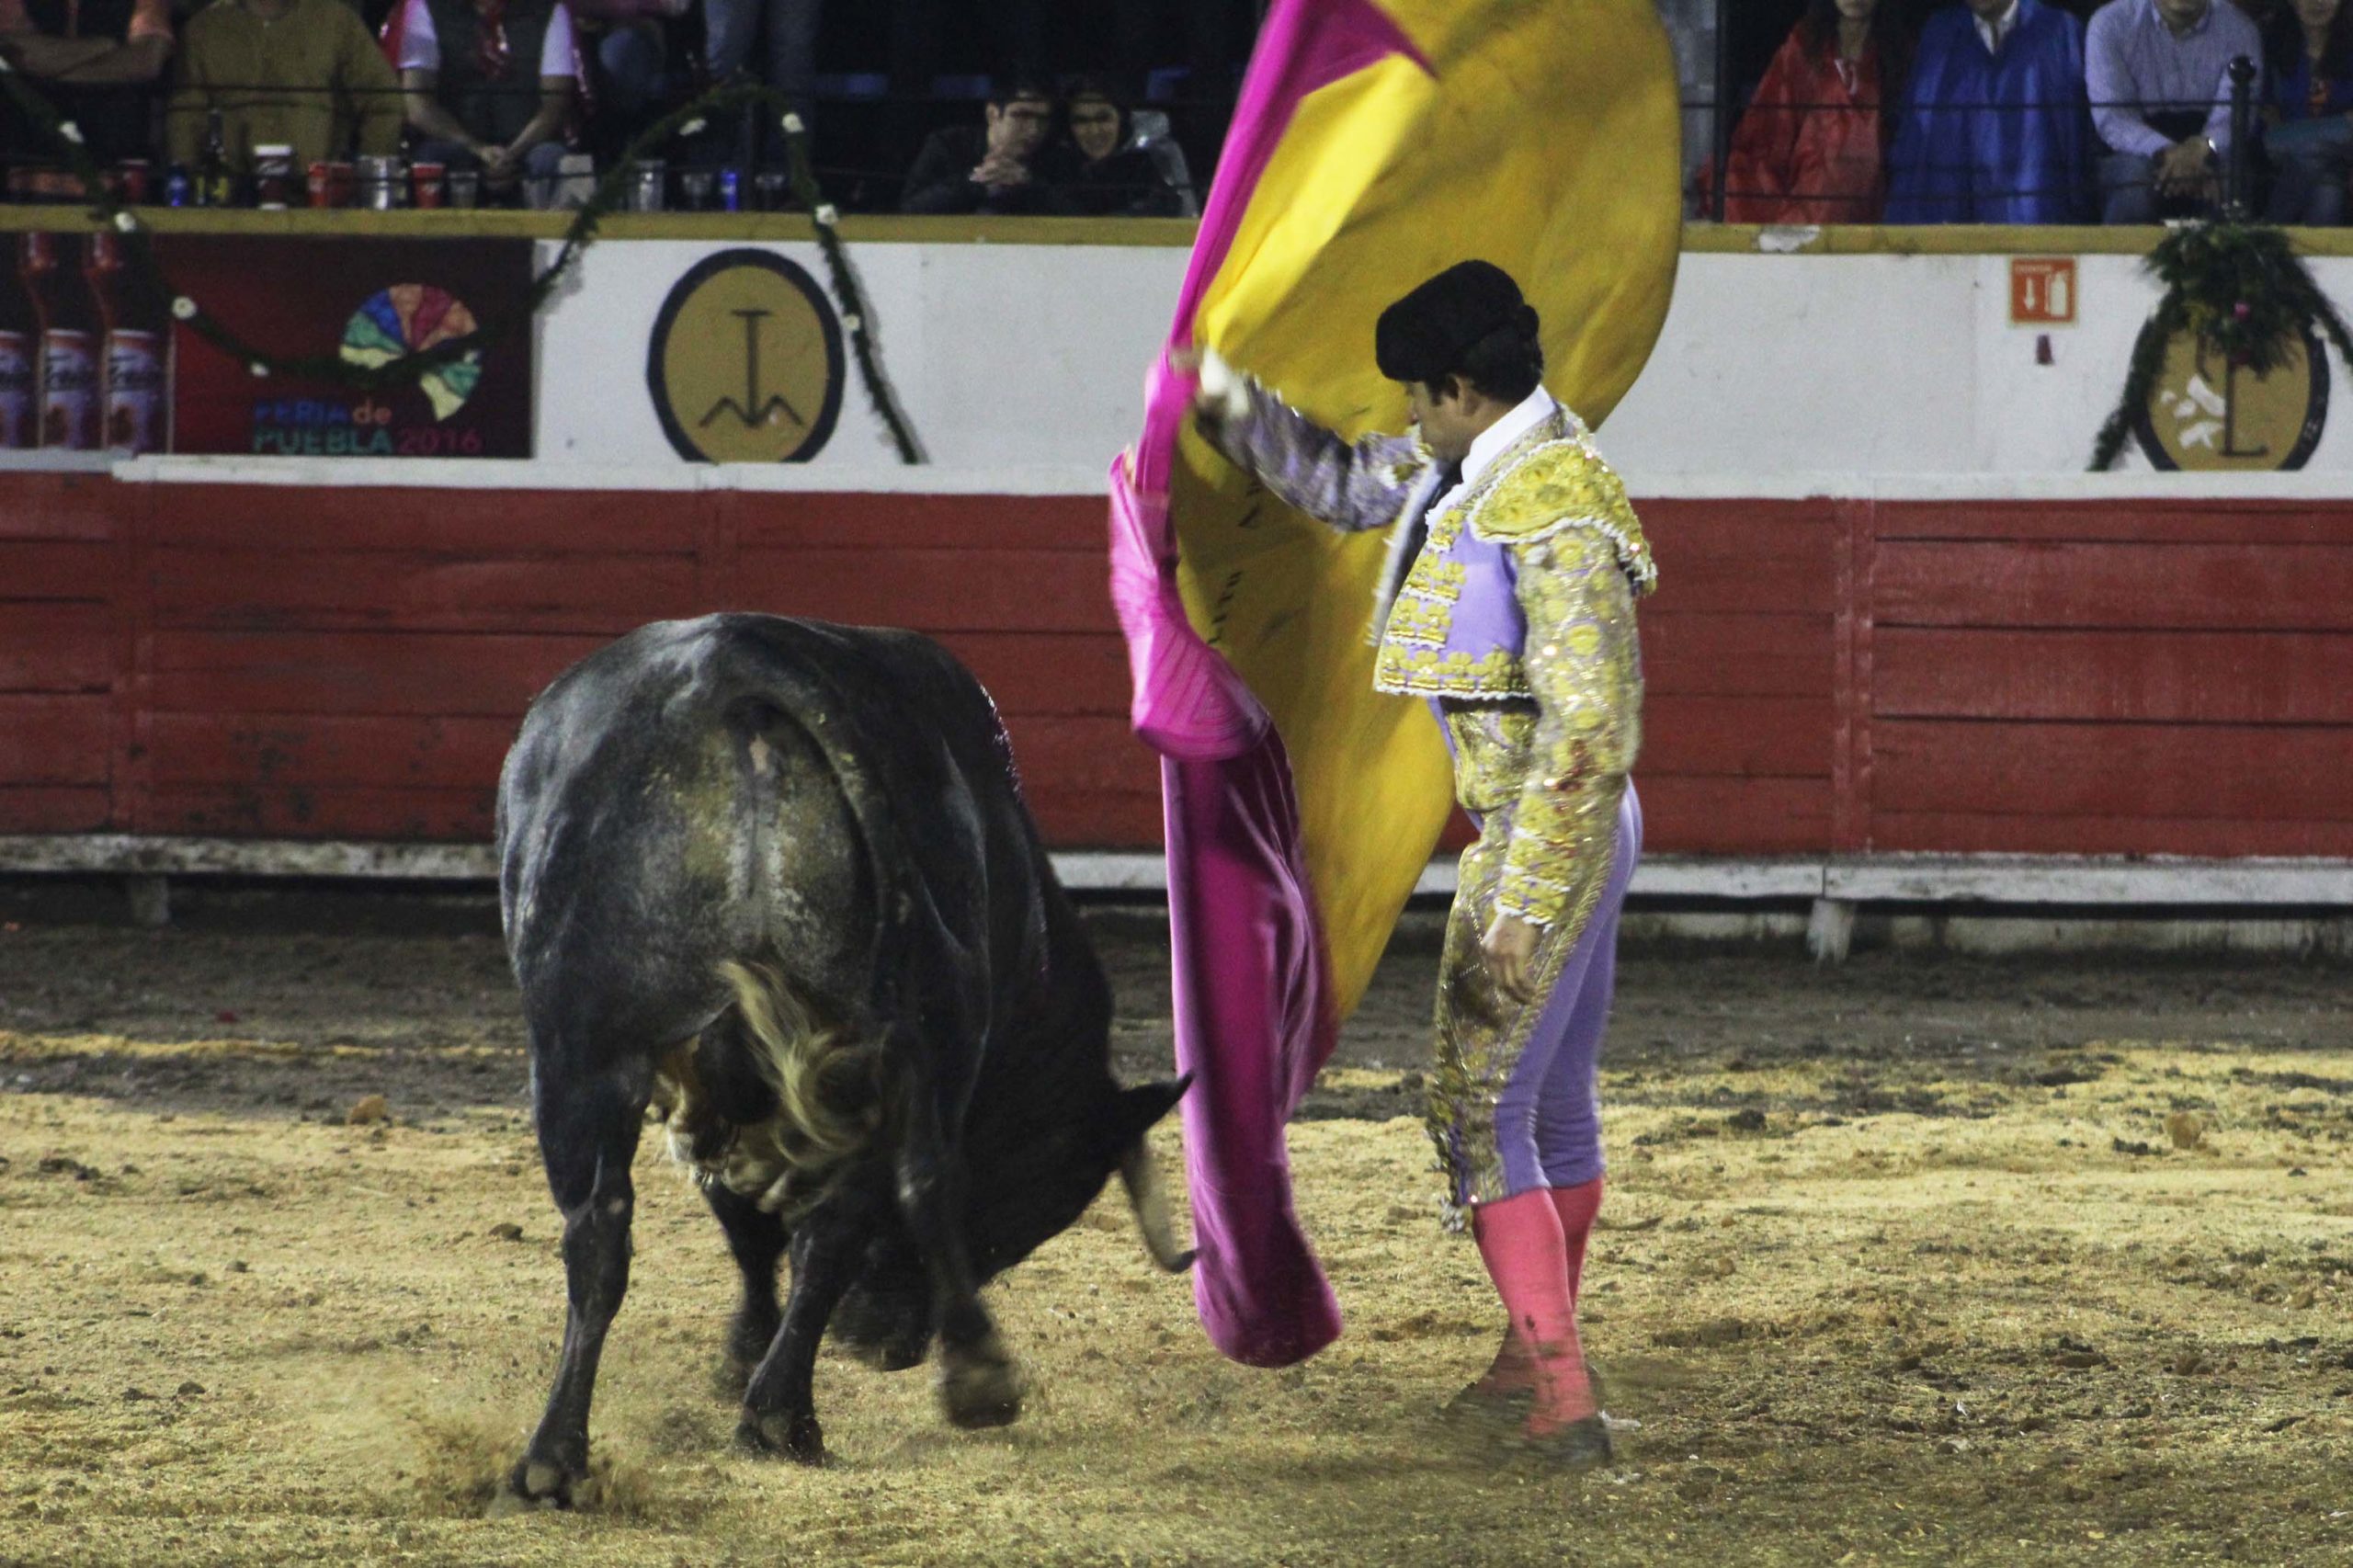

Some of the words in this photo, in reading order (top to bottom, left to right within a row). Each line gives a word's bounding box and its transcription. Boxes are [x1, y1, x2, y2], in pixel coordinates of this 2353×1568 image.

[351, 396, 392, 425] de
[254, 428, 392, 453] PUEBLA
[398, 427, 483, 453] 2016
